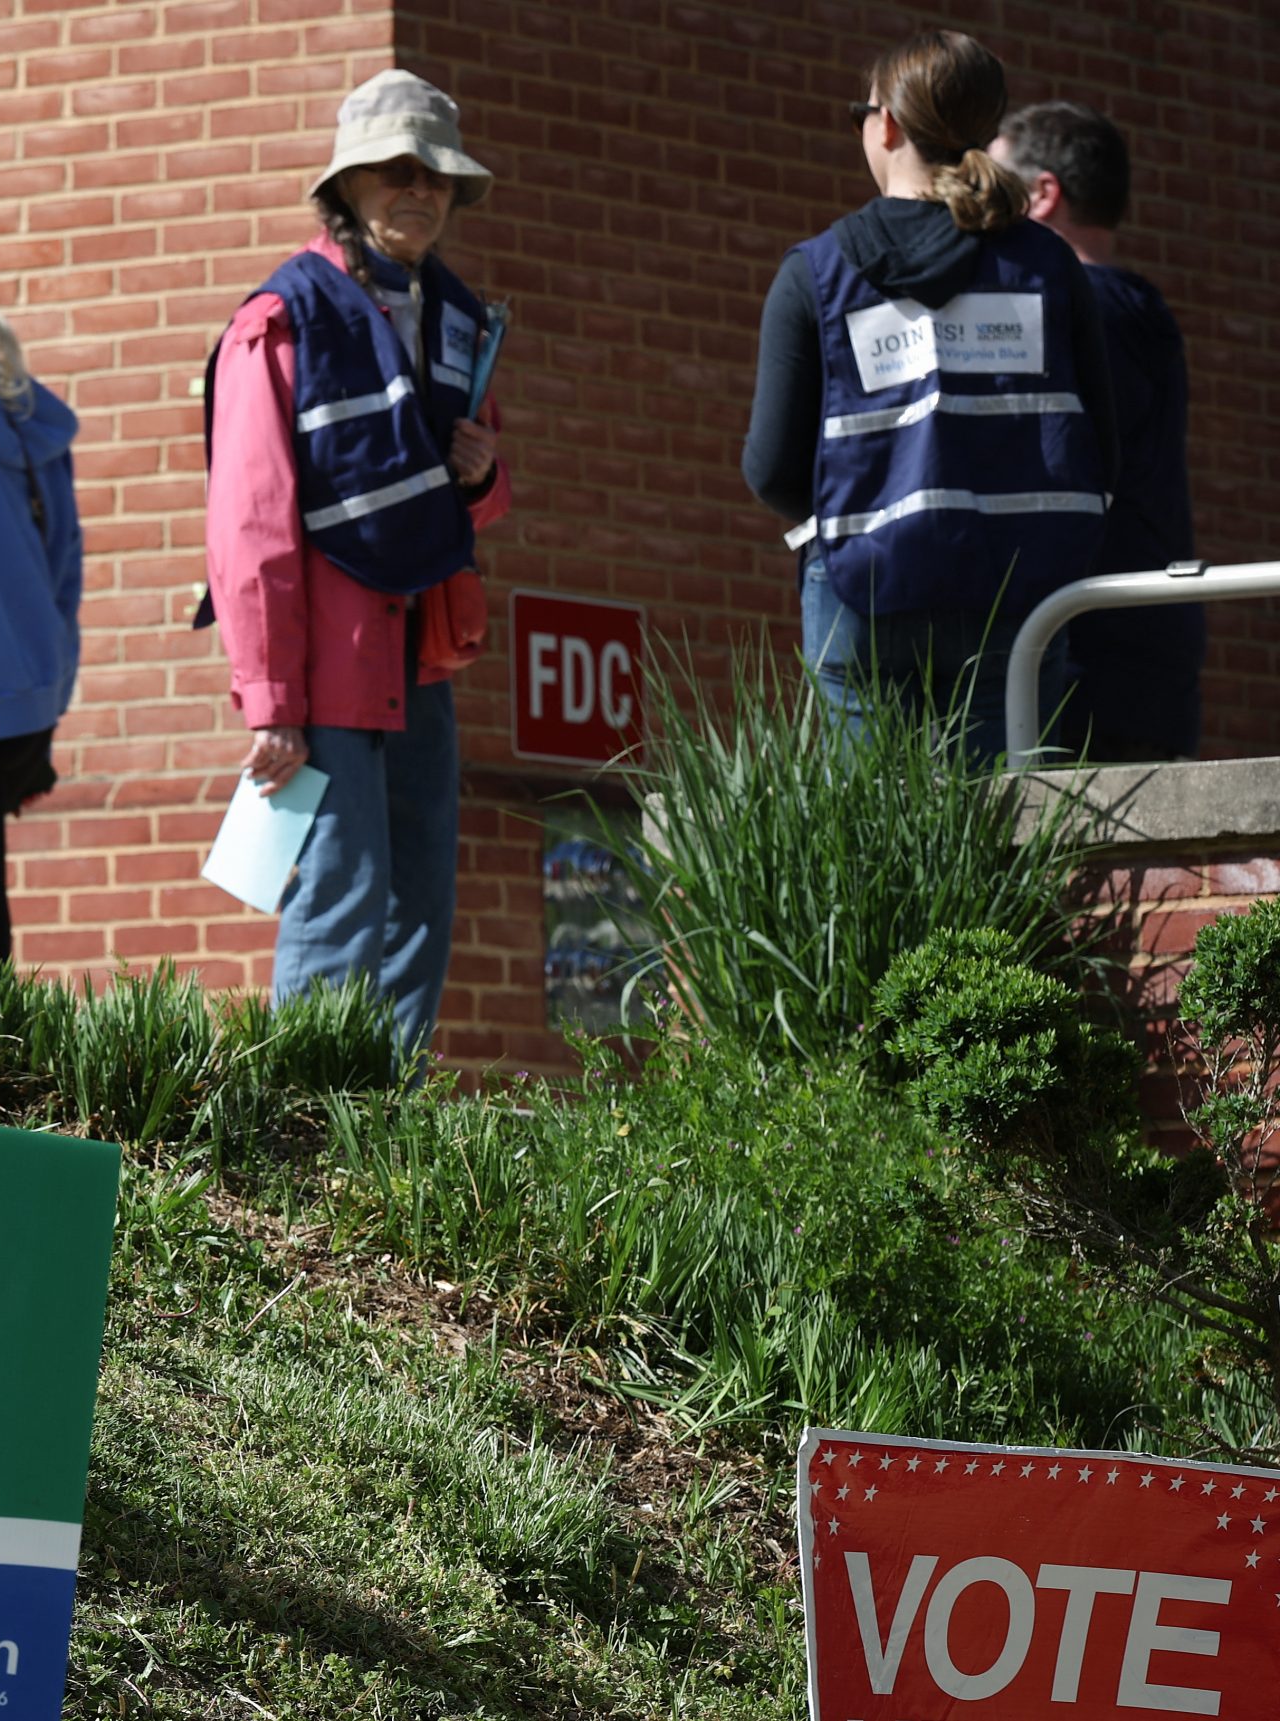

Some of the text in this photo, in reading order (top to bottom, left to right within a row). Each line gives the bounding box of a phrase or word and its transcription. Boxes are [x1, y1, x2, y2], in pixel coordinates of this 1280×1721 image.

[871, 326, 924, 357] JOIN
[933, 322, 965, 342] US!
[874, 355, 905, 375] Help
[945, 346, 996, 362] Virginia
[999, 347, 1028, 360] Blue
[528, 631, 633, 730] FDC
[843, 1551, 1233, 1717] VOTE
